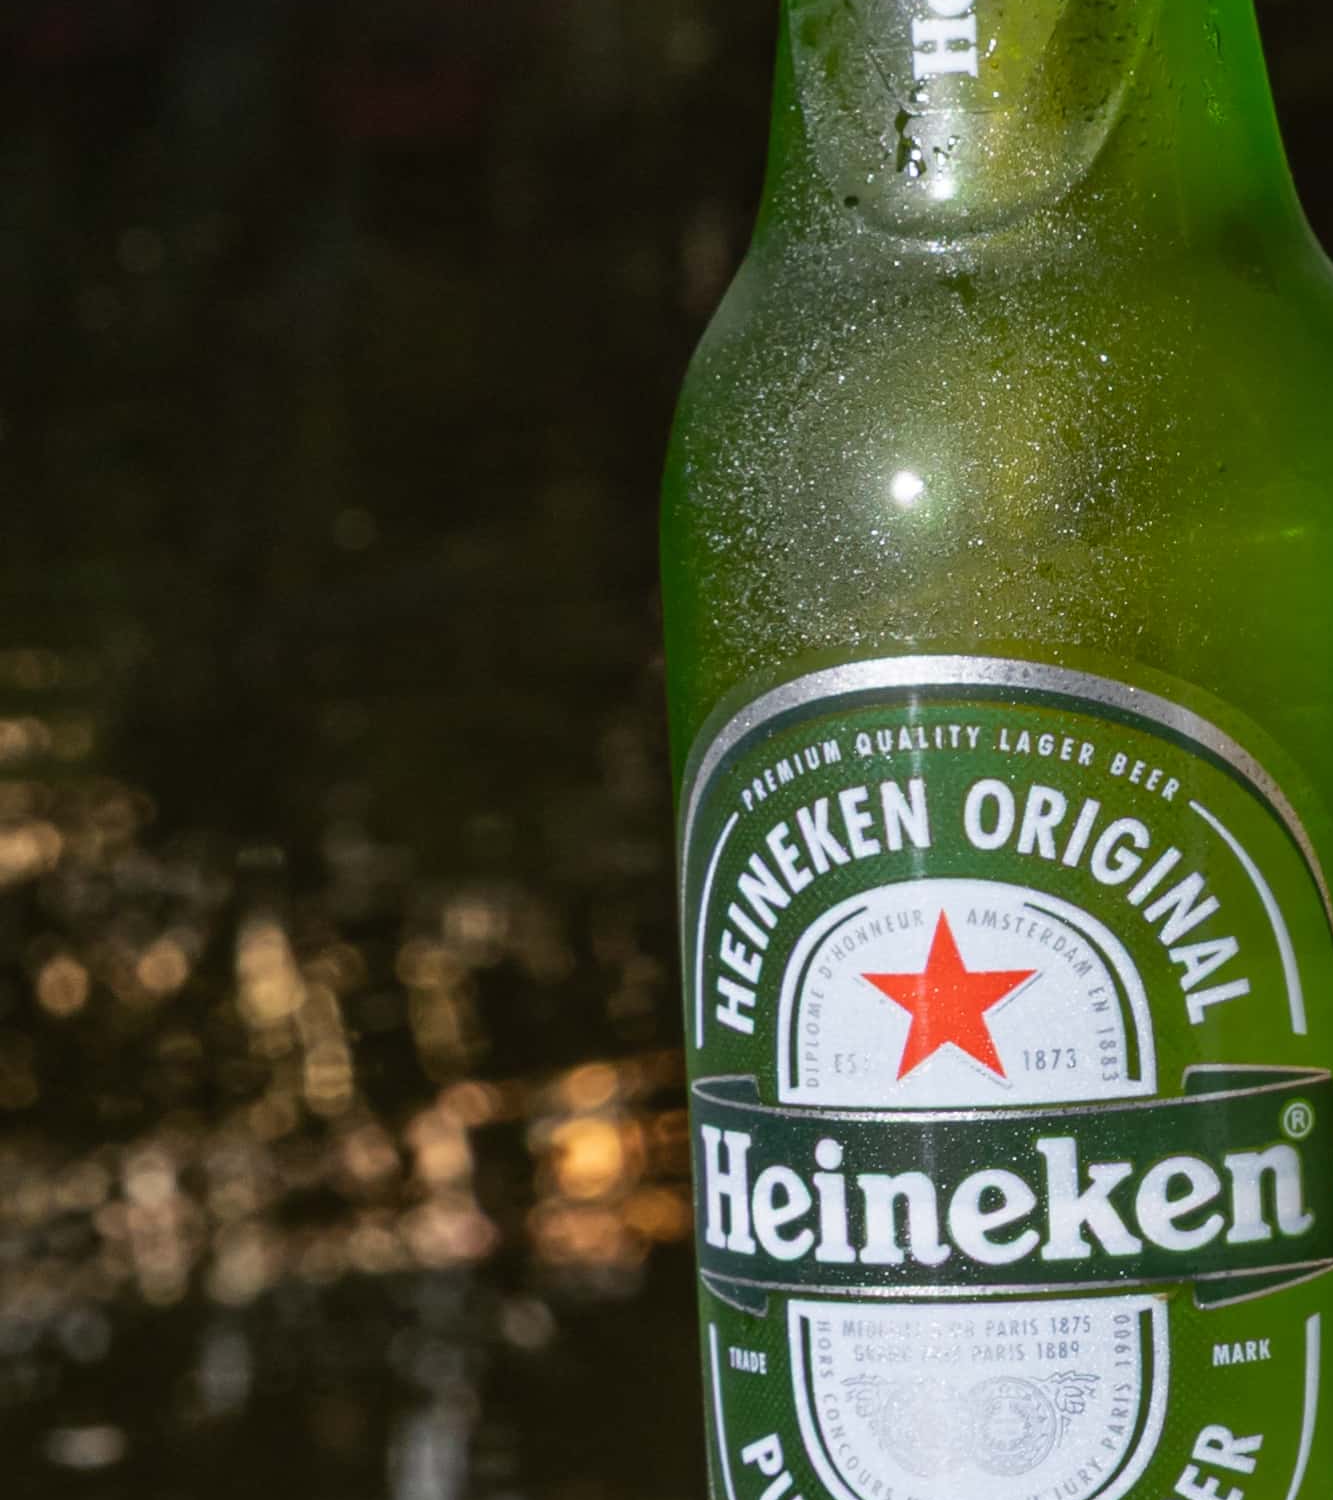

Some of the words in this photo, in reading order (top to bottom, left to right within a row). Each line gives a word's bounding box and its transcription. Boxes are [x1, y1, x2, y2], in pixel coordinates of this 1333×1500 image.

[741, 738, 842, 811] PREMIUM
[854, 724, 981, 757] QUALITY
[999, 727, 1096, 767] LAGER
[1110, 752, 1180, 802] BEER
[715, 777, 933, 1035] HEINEKEN
[963, 777, 1251, 1026] ORIGINAL
[966, 909, 1093, 979] AMSTERDAM
[1087, 985, 1111, 1014] EN
[805, 990, 825, 1088] DIPLOME
[1022, 1048, 1078, 1071] 1873
[1096, 1025, 1119, 1082] 1883
[817, 1320, 834, 1379] HORS
[1048, 1315, 1092, 1336] 1875
[1113, 1313, 1132, 1368] 1900
[1212, 1339, 1271, 1367] MARK
[728, 1346, 768, 1375] TRADE
[1101, 1382, 1133, 1451] PARIS
